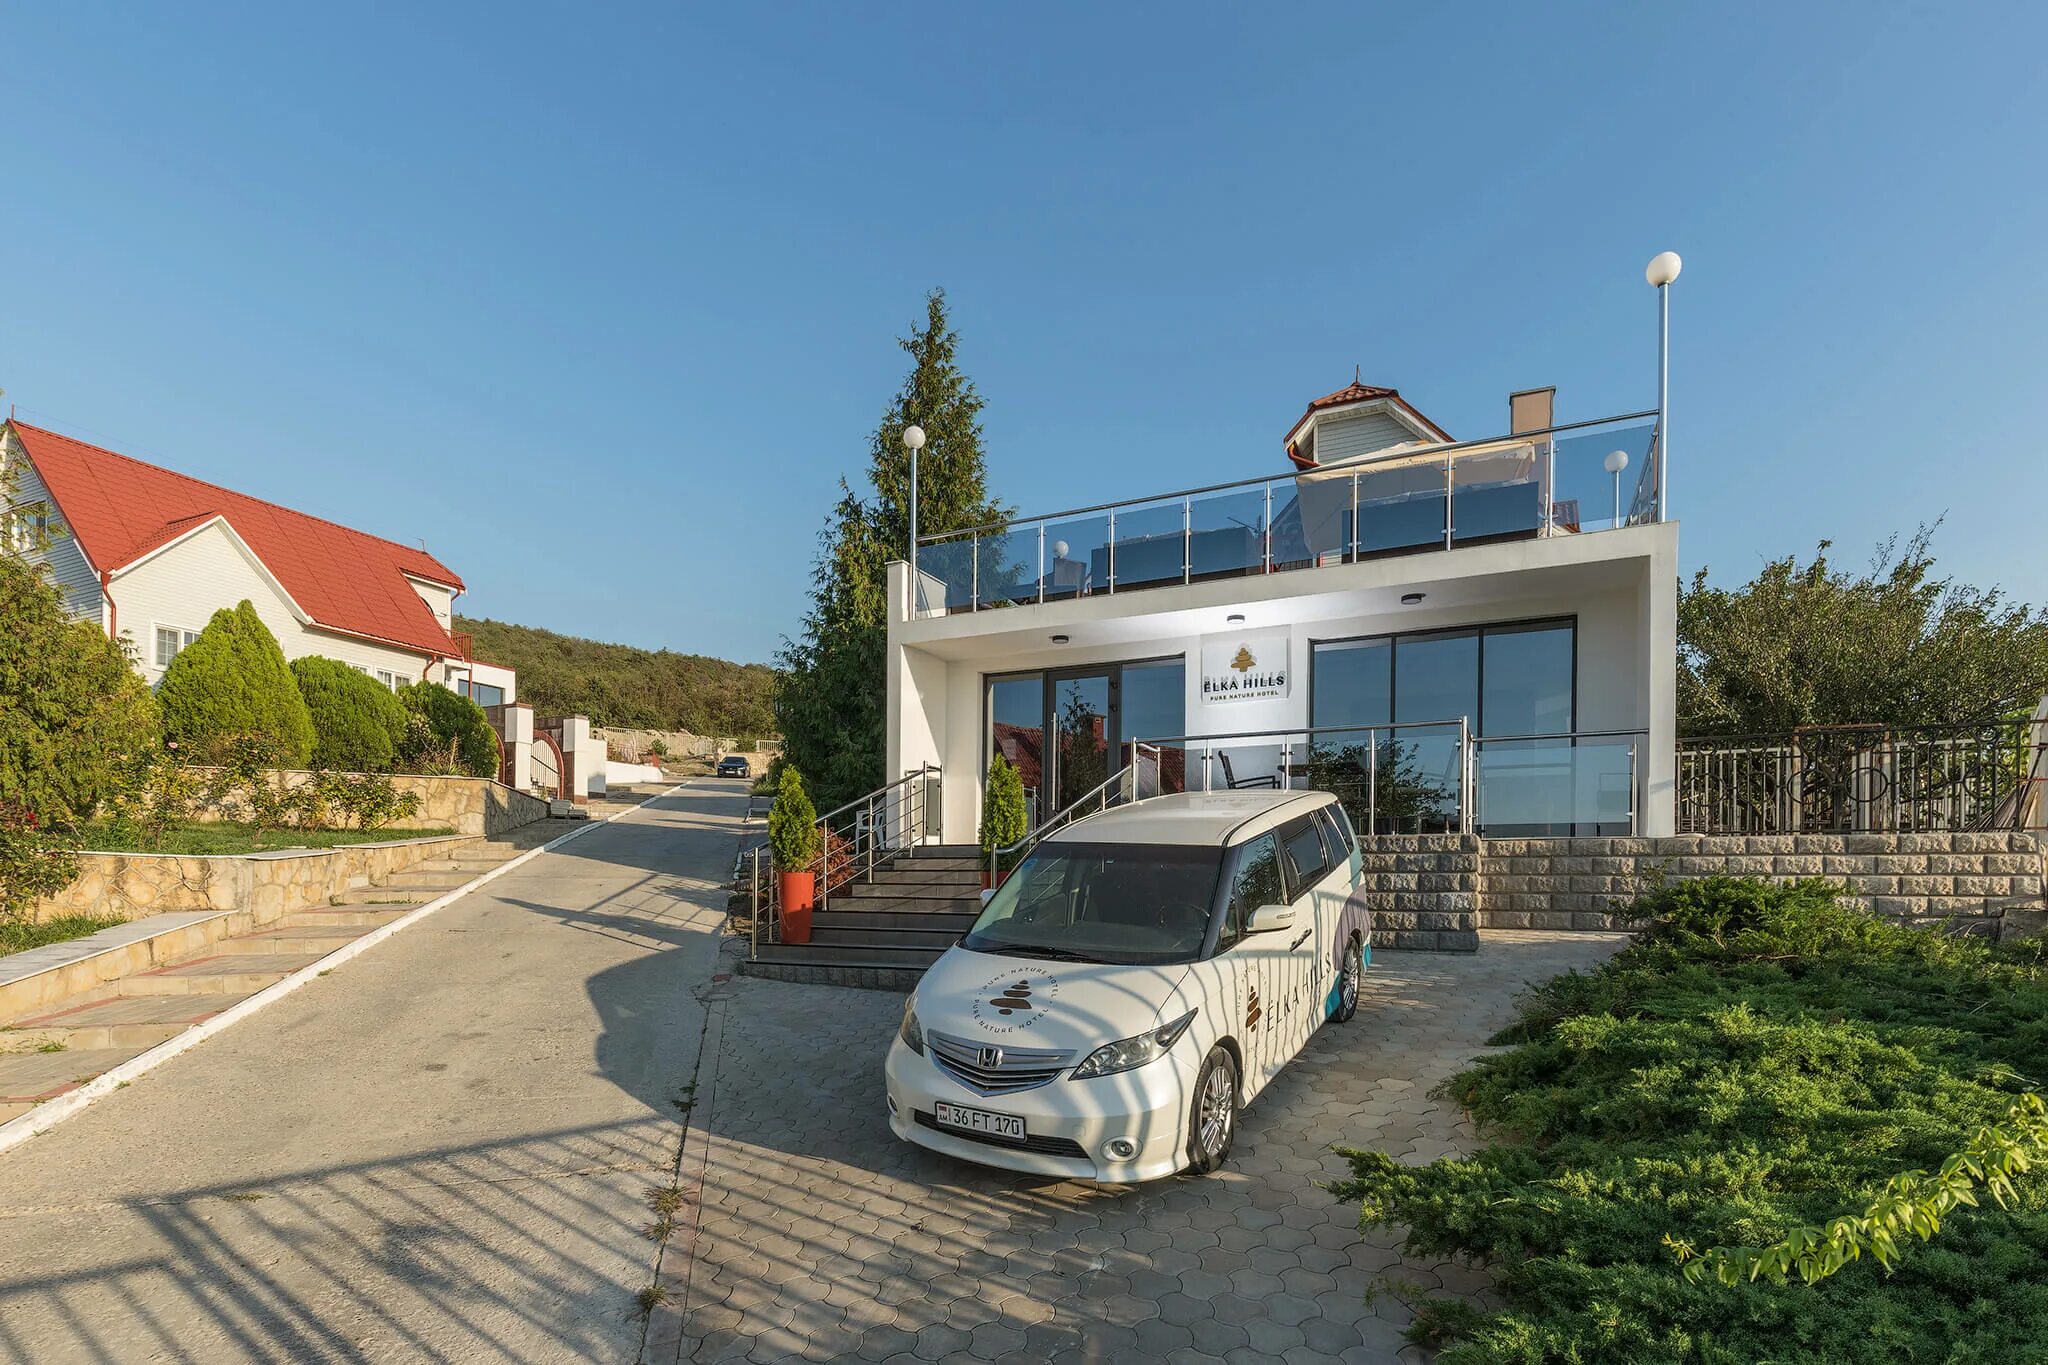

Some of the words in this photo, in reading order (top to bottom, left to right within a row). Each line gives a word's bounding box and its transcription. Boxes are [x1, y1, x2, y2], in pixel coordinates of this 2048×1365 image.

[1204, 680, 1238, 692] ËLKA
[1243, 676, 1283, 688] HILLS
[1010, 967, 1048, 975] NATURE
[1047, 975, 1060, 998] HOTEL
[1302, 952, 1332, 995] HILLS
[972, 998, 981, 1020] PURE
[978, 1020, 1013, 1033] NATURE
[1018, 1008, 1049, 1030] HOTEL
[953, 1108, 969, 1125] 36
[972, 1112, 990, 1129] FT
[995, 1116, 1019, 1135] 170
